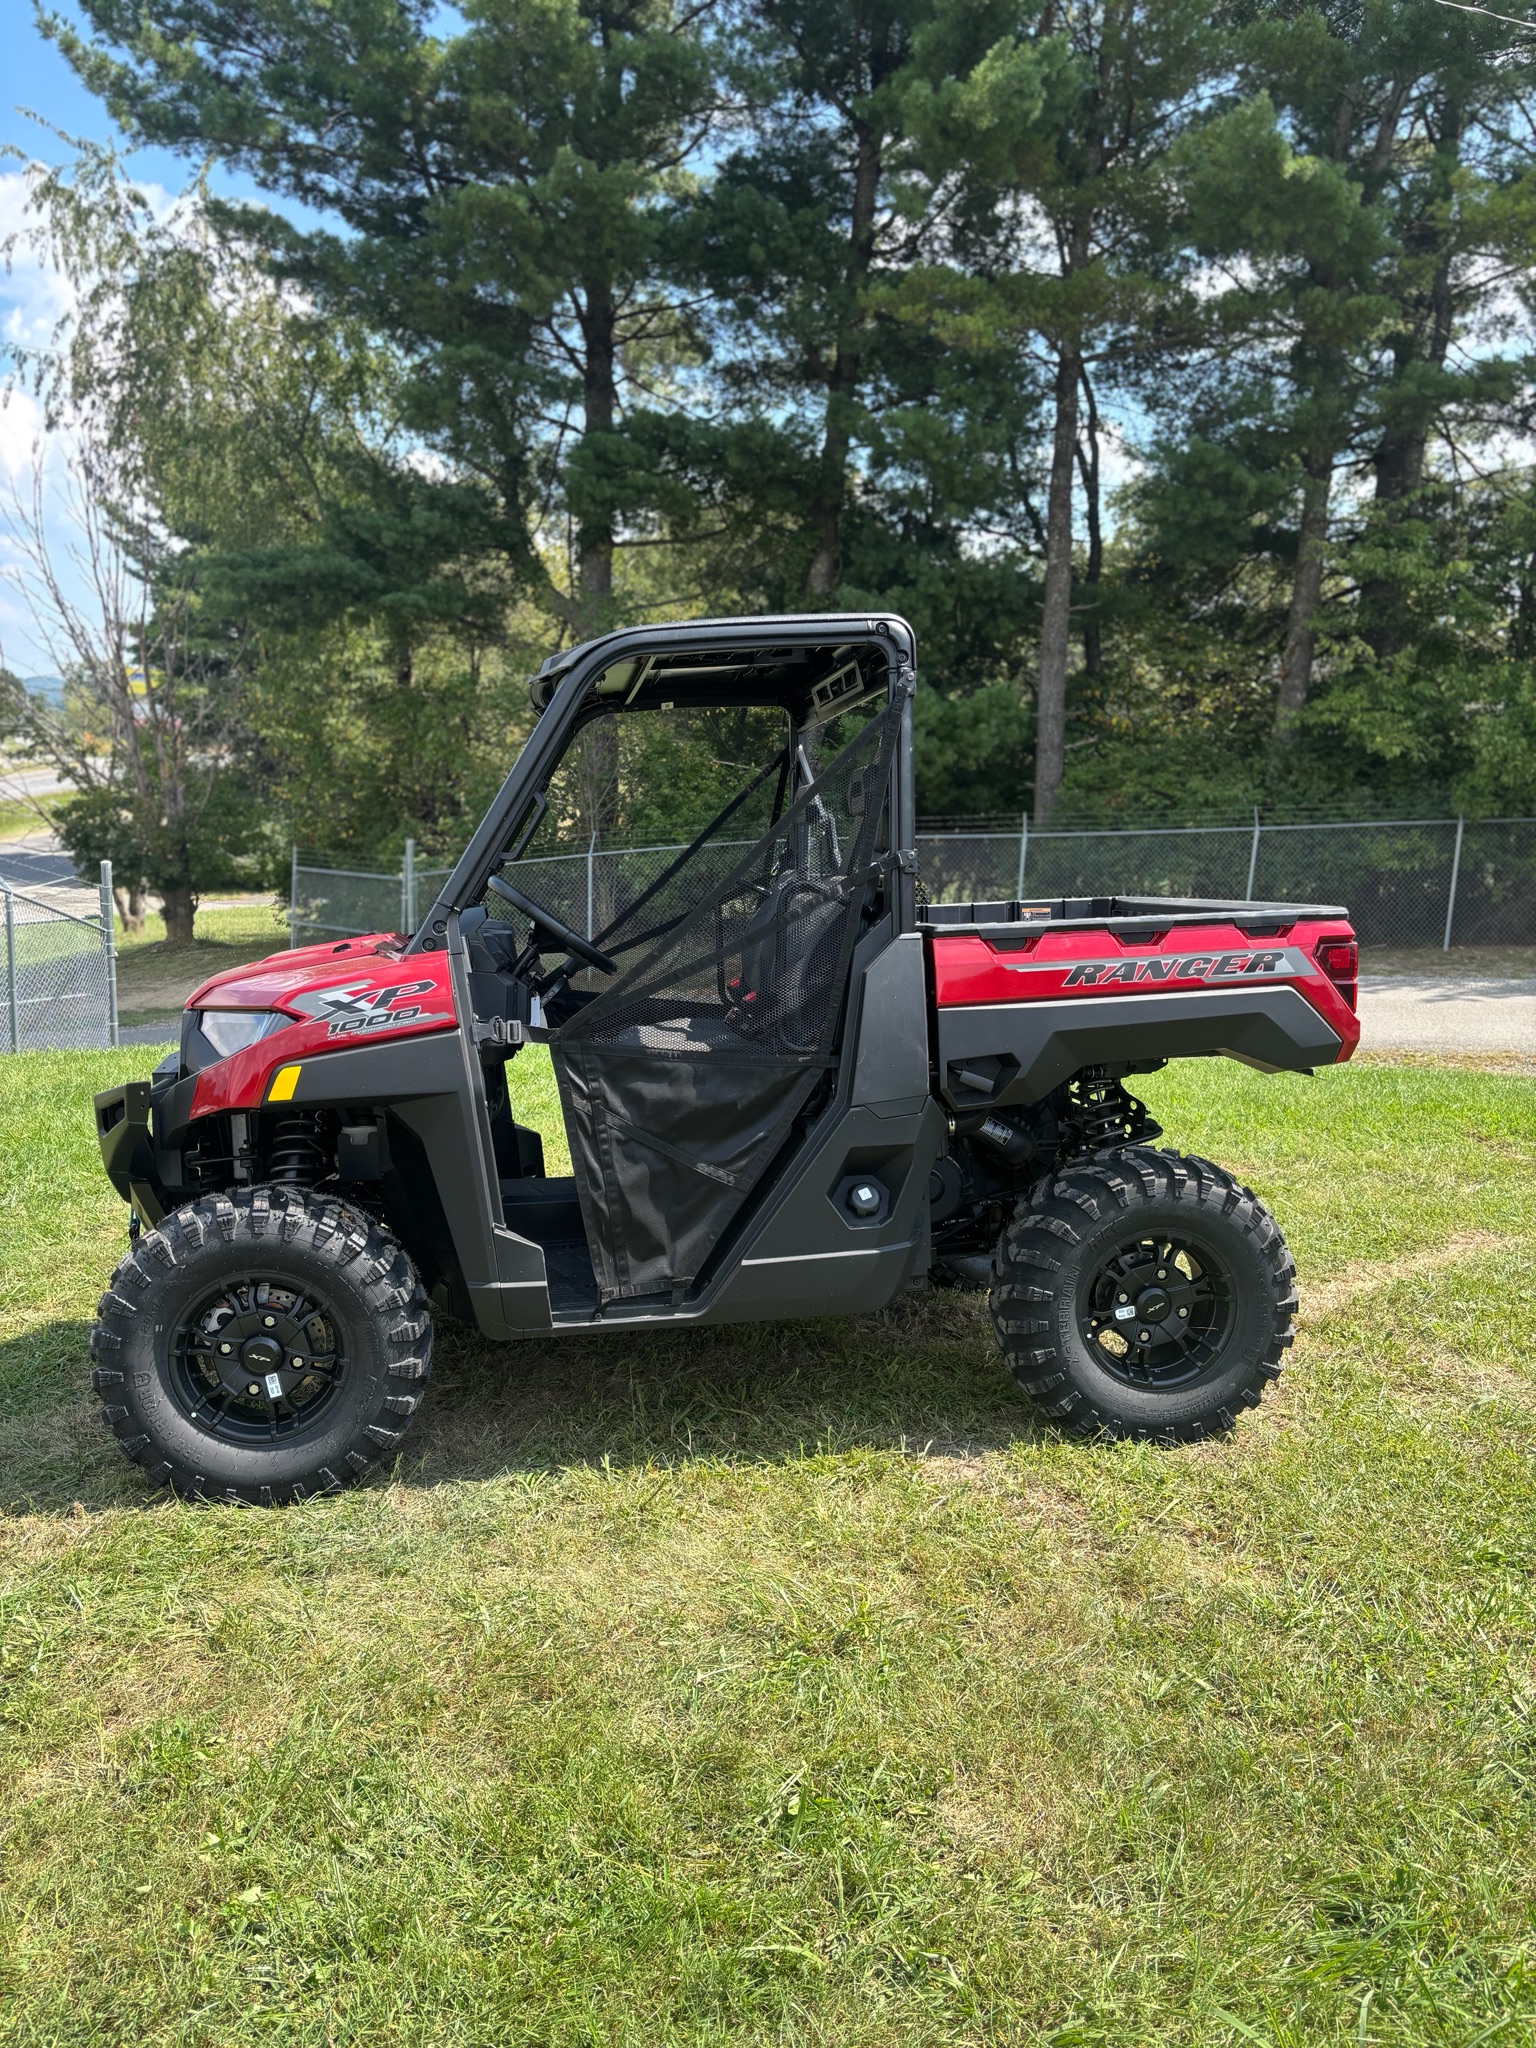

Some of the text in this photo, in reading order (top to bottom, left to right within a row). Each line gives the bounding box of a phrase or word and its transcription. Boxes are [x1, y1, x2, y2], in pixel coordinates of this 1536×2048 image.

[1061, 951, 1285, 987] RANGER
[299, 979, 438, 1027] XP
[327, 1006, 421, 1036] 1000
[248, 1353, 271, 1362] XP
